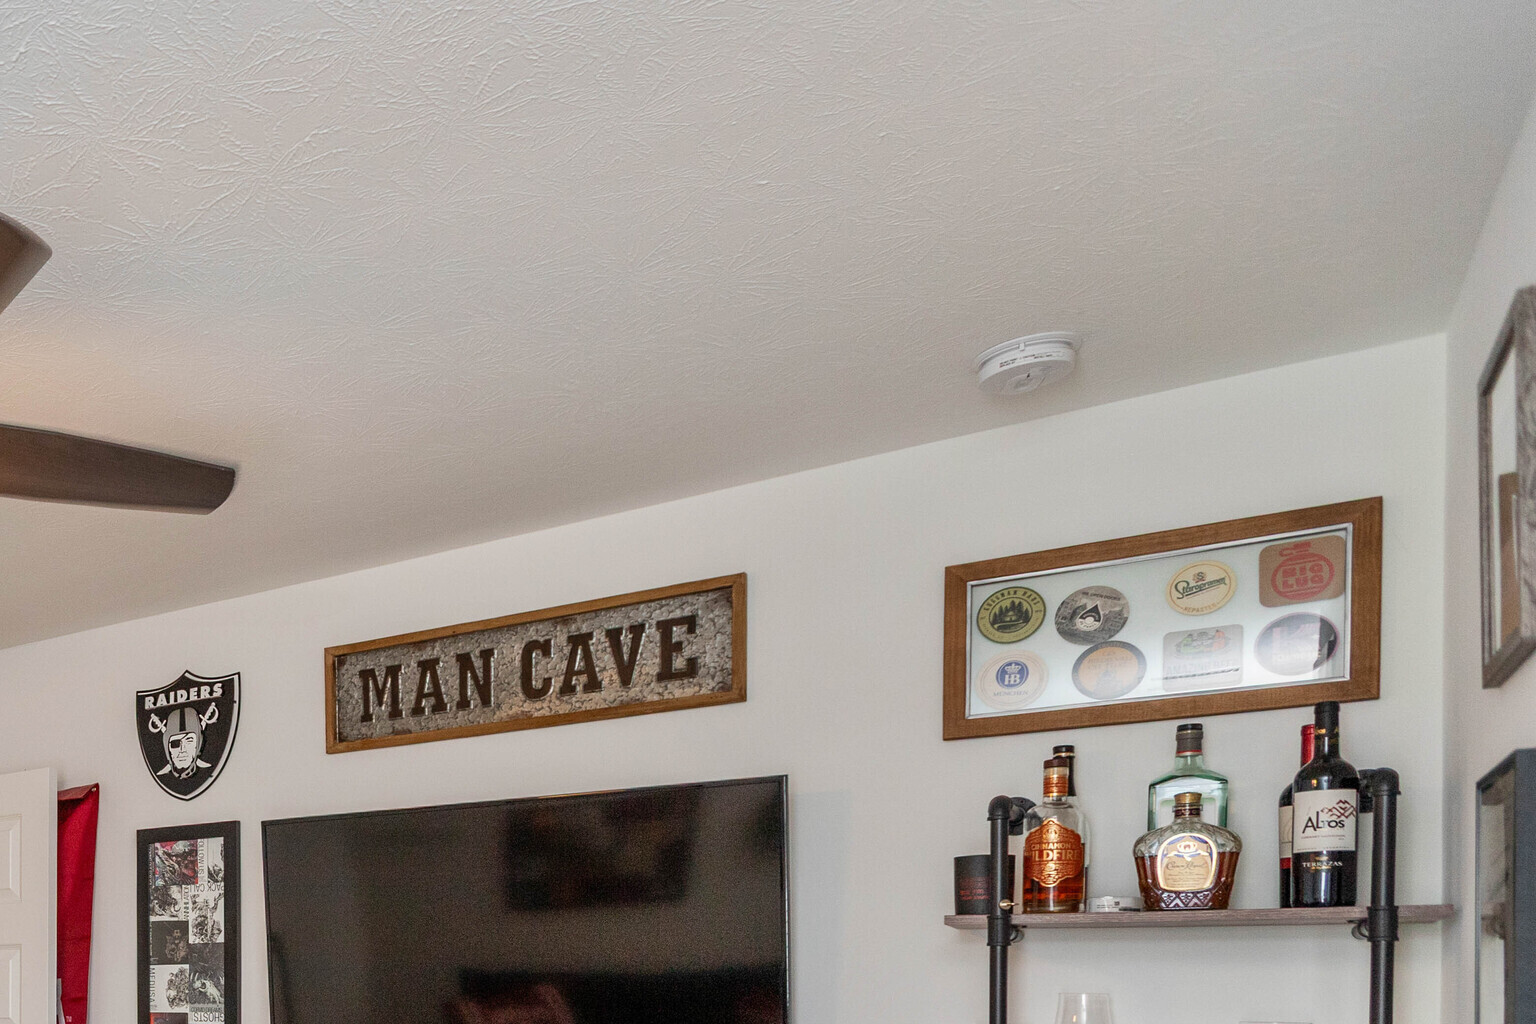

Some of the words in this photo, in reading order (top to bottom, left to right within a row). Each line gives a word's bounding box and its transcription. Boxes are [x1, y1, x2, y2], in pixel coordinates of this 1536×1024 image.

[1282, 563, 1324, 578] BIG
[1174, 577, 1228, 600] Staropramen
[1282, 575, 1324, 590] LUG
[359, 648, 497, 723] MAN
[521, 615, 699, 701] CAVE
[1004, 674, 1020, 686] HB
[144, 683, 223, 710] RAIDERS
[1031, 842, 1072, 850] CINNAMON
[1302, 861, 1343, 869] TERRAZAS
[193, 1012, 224, 1022] GHOSTS
